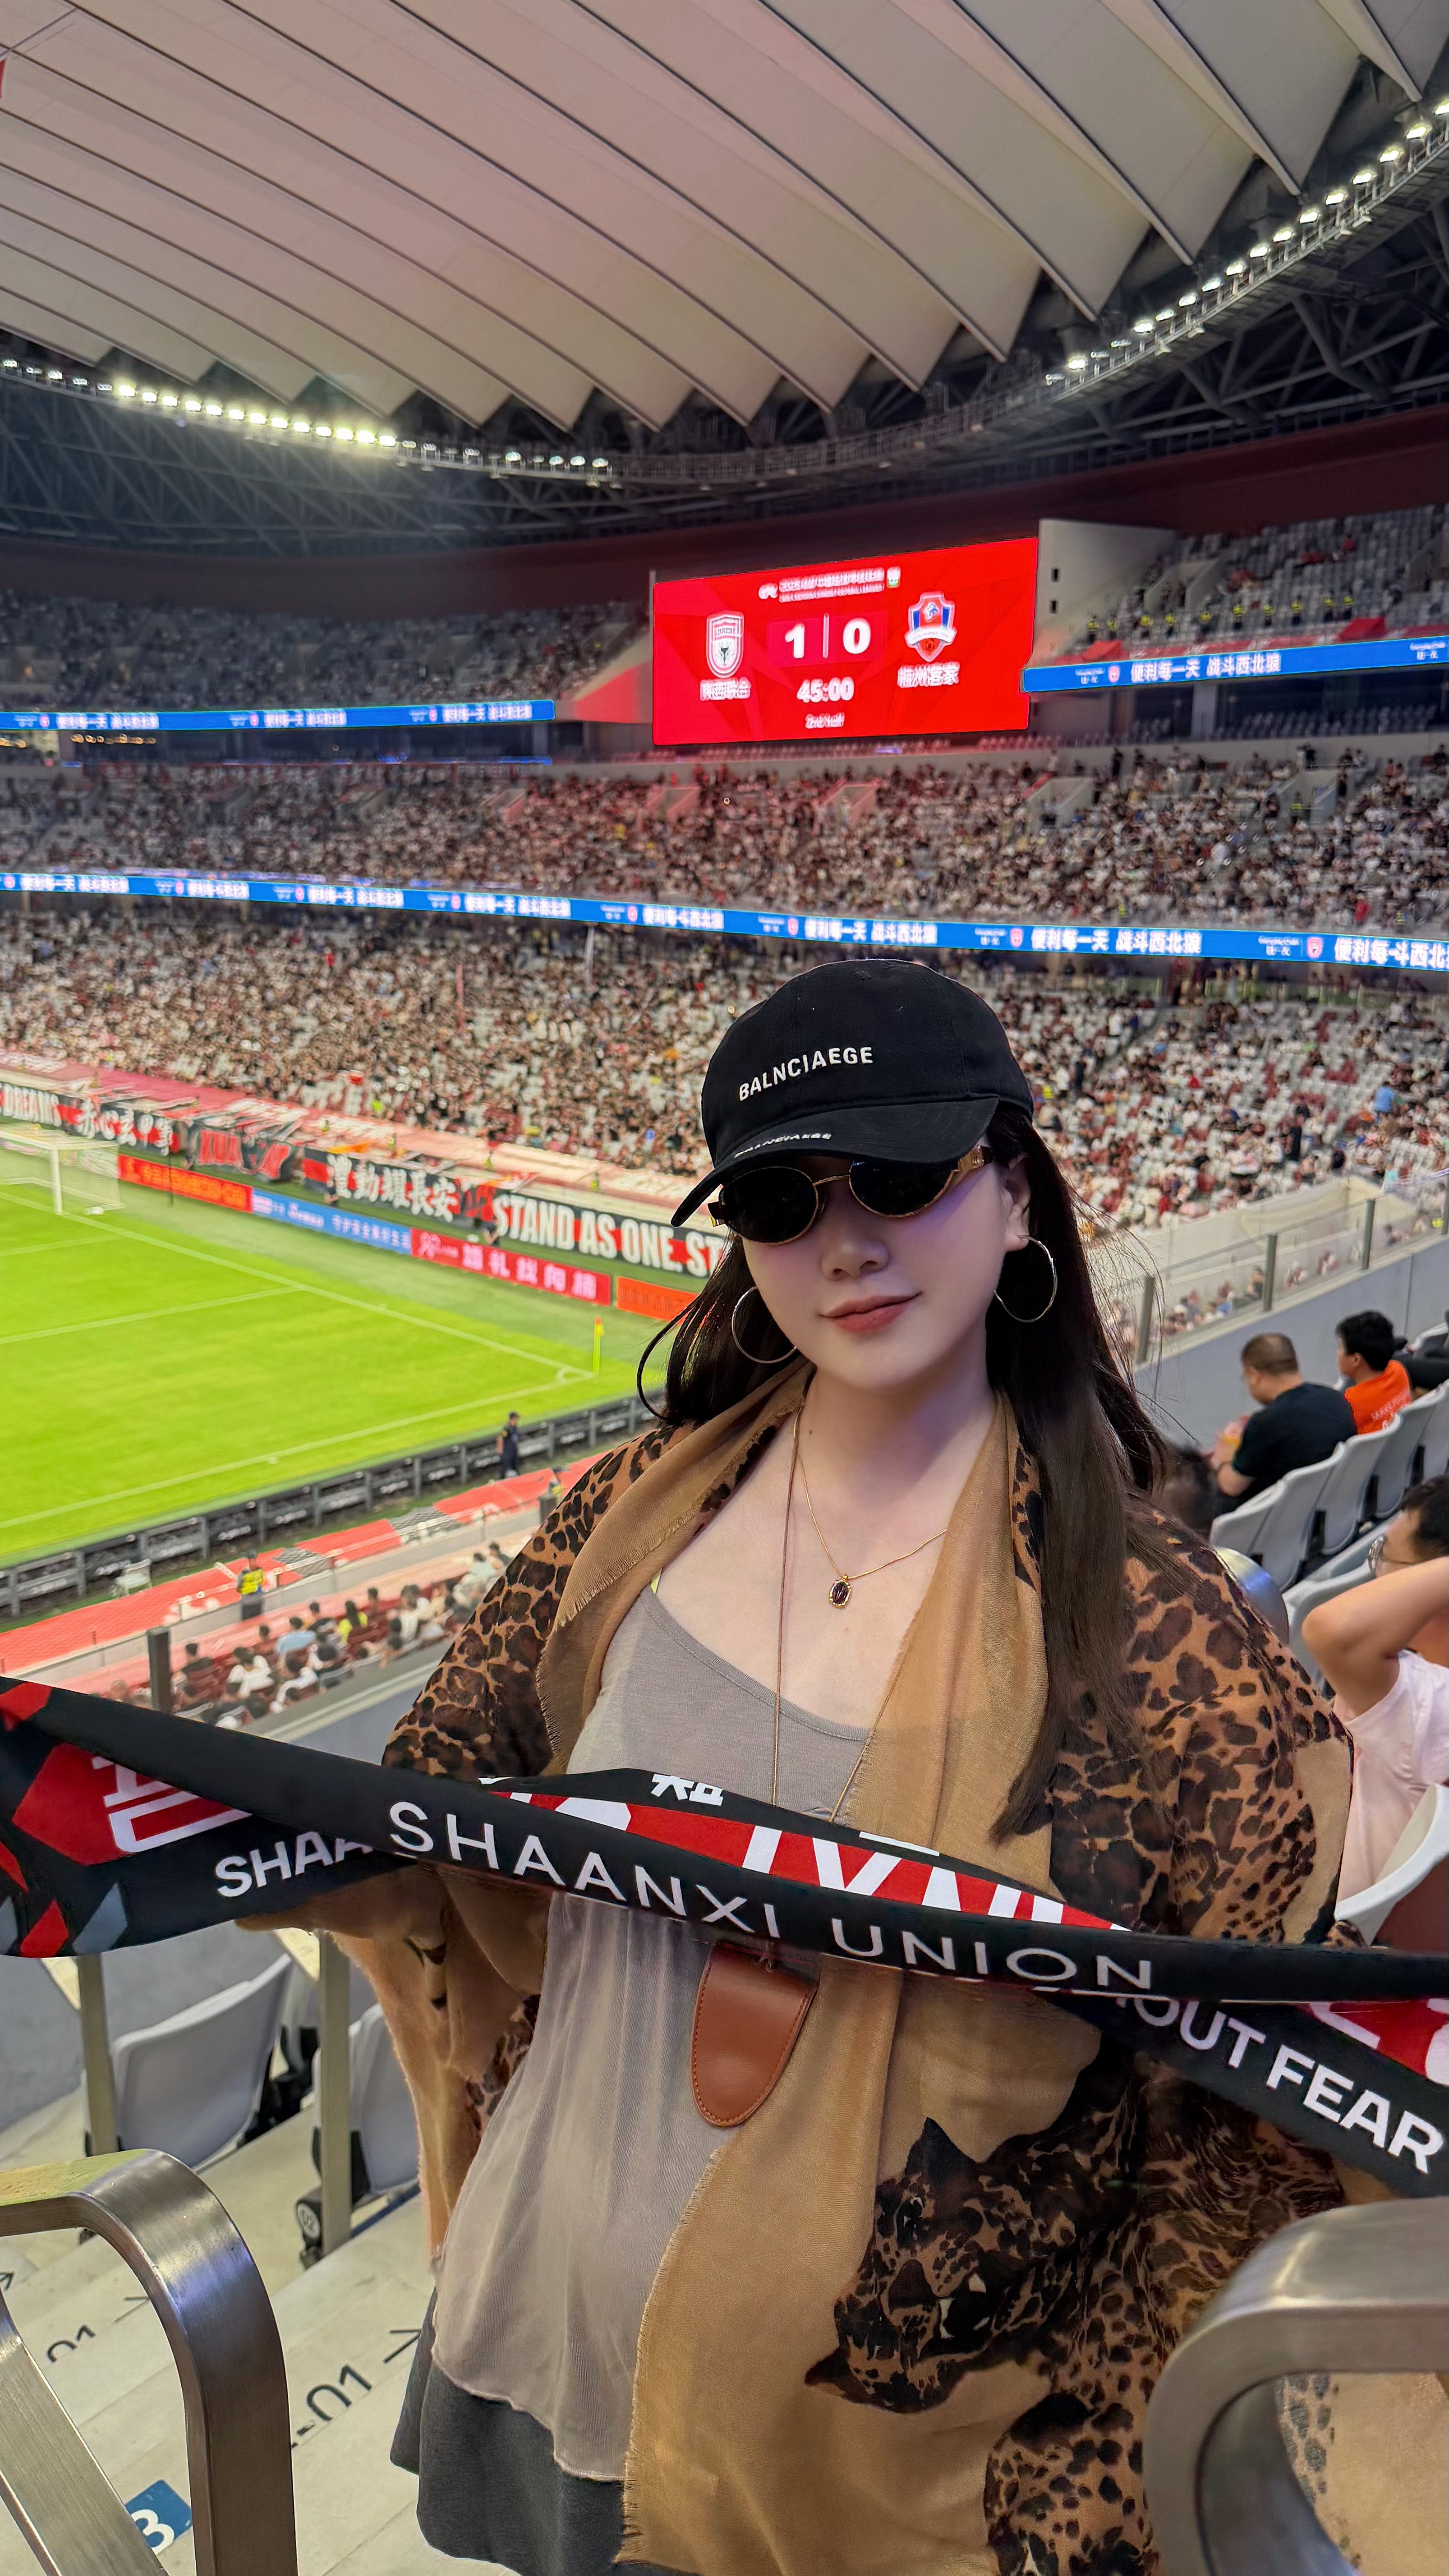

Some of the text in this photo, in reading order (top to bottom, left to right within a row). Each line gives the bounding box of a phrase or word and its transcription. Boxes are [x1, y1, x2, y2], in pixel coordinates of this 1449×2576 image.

[785, 617, 871, 658] 1 0
[796, 676, 854, 703] 45:00
[1131, 659, 1201, 683] 便利每一天
[739, 1046, 874, 1101] BALNCIAEGE
[493, 1193, 575, 1250] STAND
[578, 1210, 619, 1259] AS
[621, 1218, 684, 1274] ONE.
[389, 1801, 780, 1938] SHAANXI
[832, 1918, 1151, 1989] UNION
[1266, 2045, 1444, 2174] FEAR
